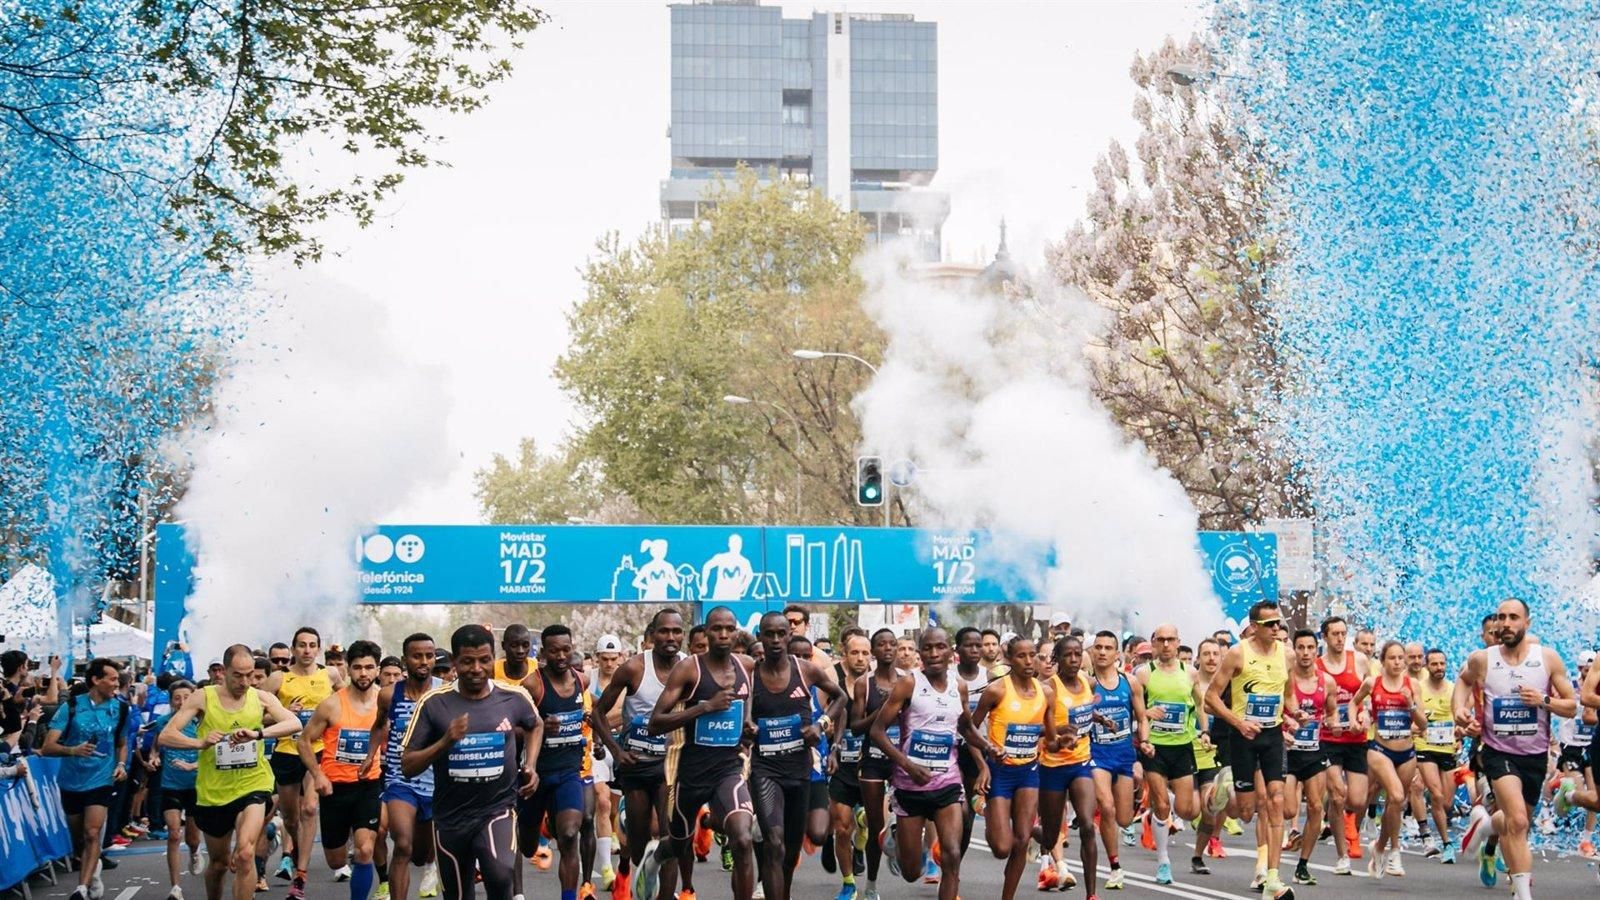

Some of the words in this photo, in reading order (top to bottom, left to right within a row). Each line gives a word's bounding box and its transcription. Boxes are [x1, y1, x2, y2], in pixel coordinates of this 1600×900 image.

[500, 532, 546, 542] Movistar
[500, 542, 546, 559] MAD
[933, 545, 975, 560] MAD
[500, 559, 546, 583] 1/2
[932, 561, 976, 584] 1/2
[358, 571, 425, 583] Telefónica
[394, 585, 413, 594] 1924
[499, 583, 546, 594] MARATÓN
[1500, 711, 1531, 719] PACER
[708, 721, 735, 730] PACE
[769, 729, 792, 739] MIKE
[231, 745, 245, 753] 269
[914, 743, 949, 755] KARIUKI
